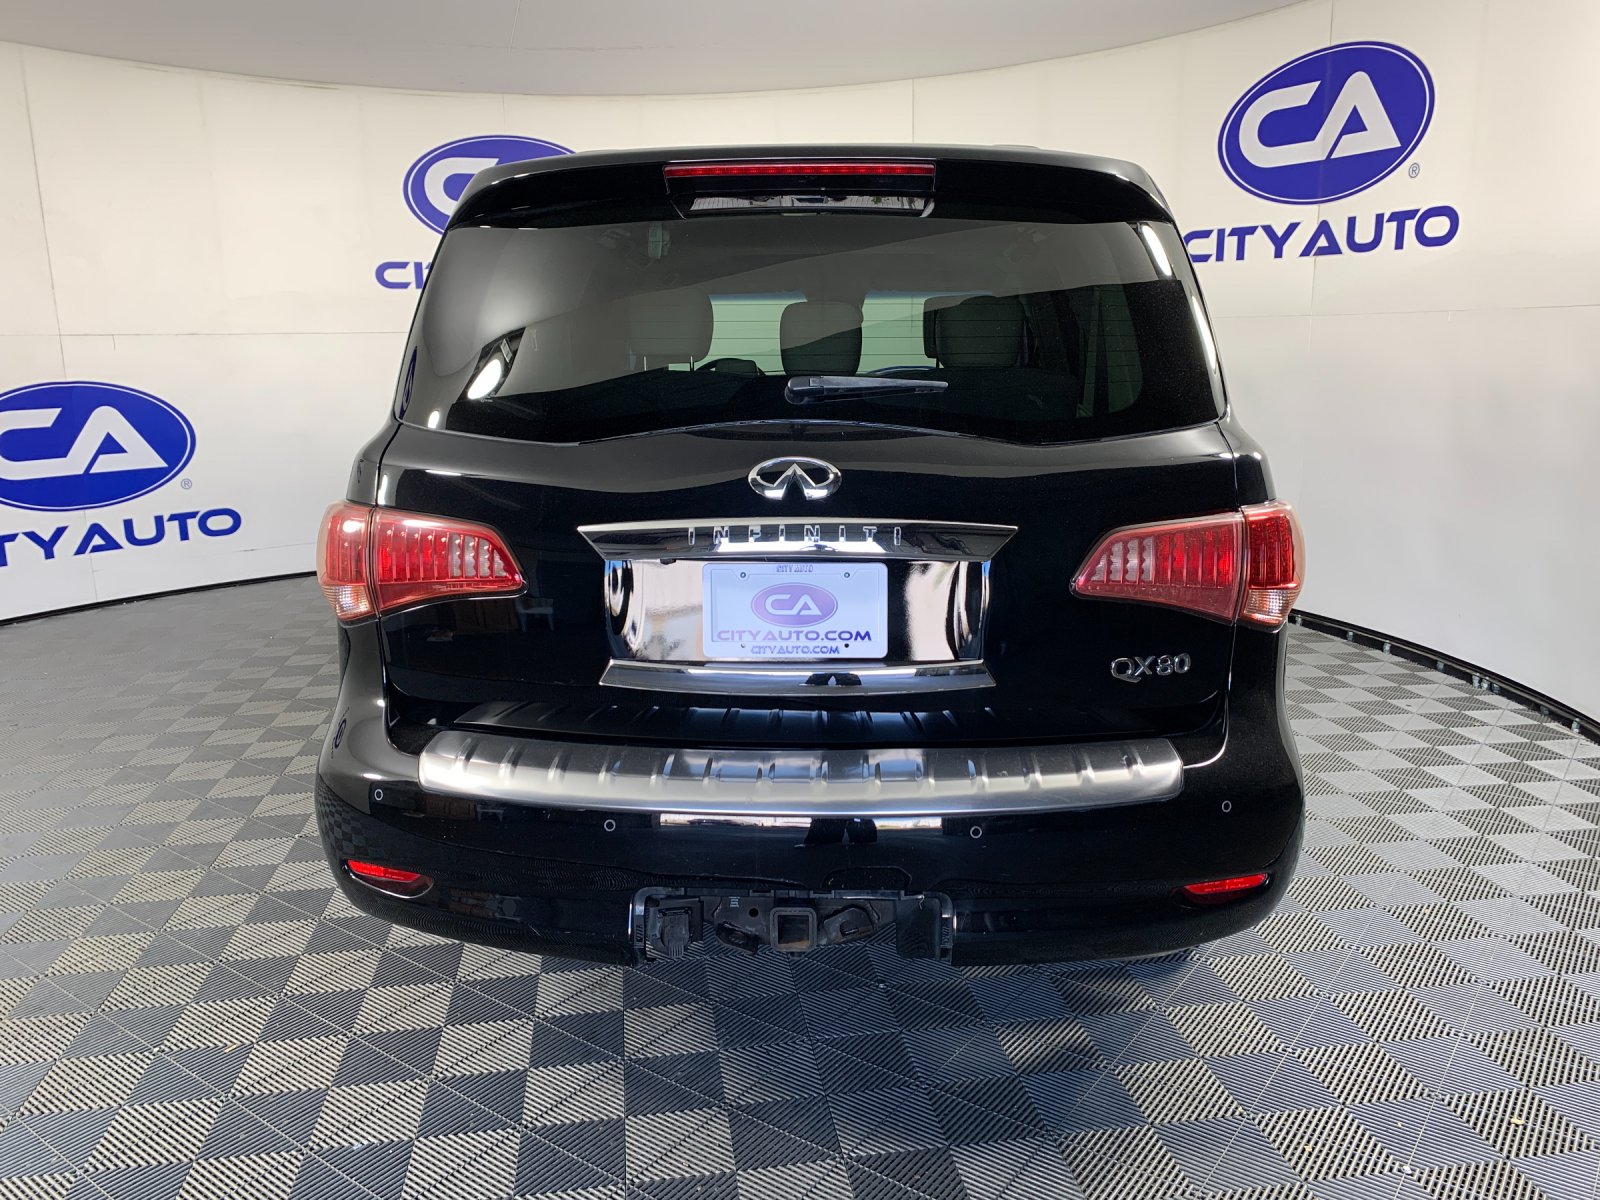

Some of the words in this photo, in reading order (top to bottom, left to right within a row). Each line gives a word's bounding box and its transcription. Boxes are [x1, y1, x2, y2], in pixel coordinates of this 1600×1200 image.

[1239, 70, 1402, 169] CA
[424, 156, 500, 217] C
[1183, 222, 1301, 263] CITY
[1298, 205, 1460, 258] AUTO
[375, 261, 432, 290] CI
[0, 405, 169, 481] CA
[0, 525, 70, 568] TY
[73, 507, 242, 557] AUTO
[687, 524, 902, 546] INFINITI
[765, 594, 823, 616] CA
[1110, 652, 1192, 684] QX80
